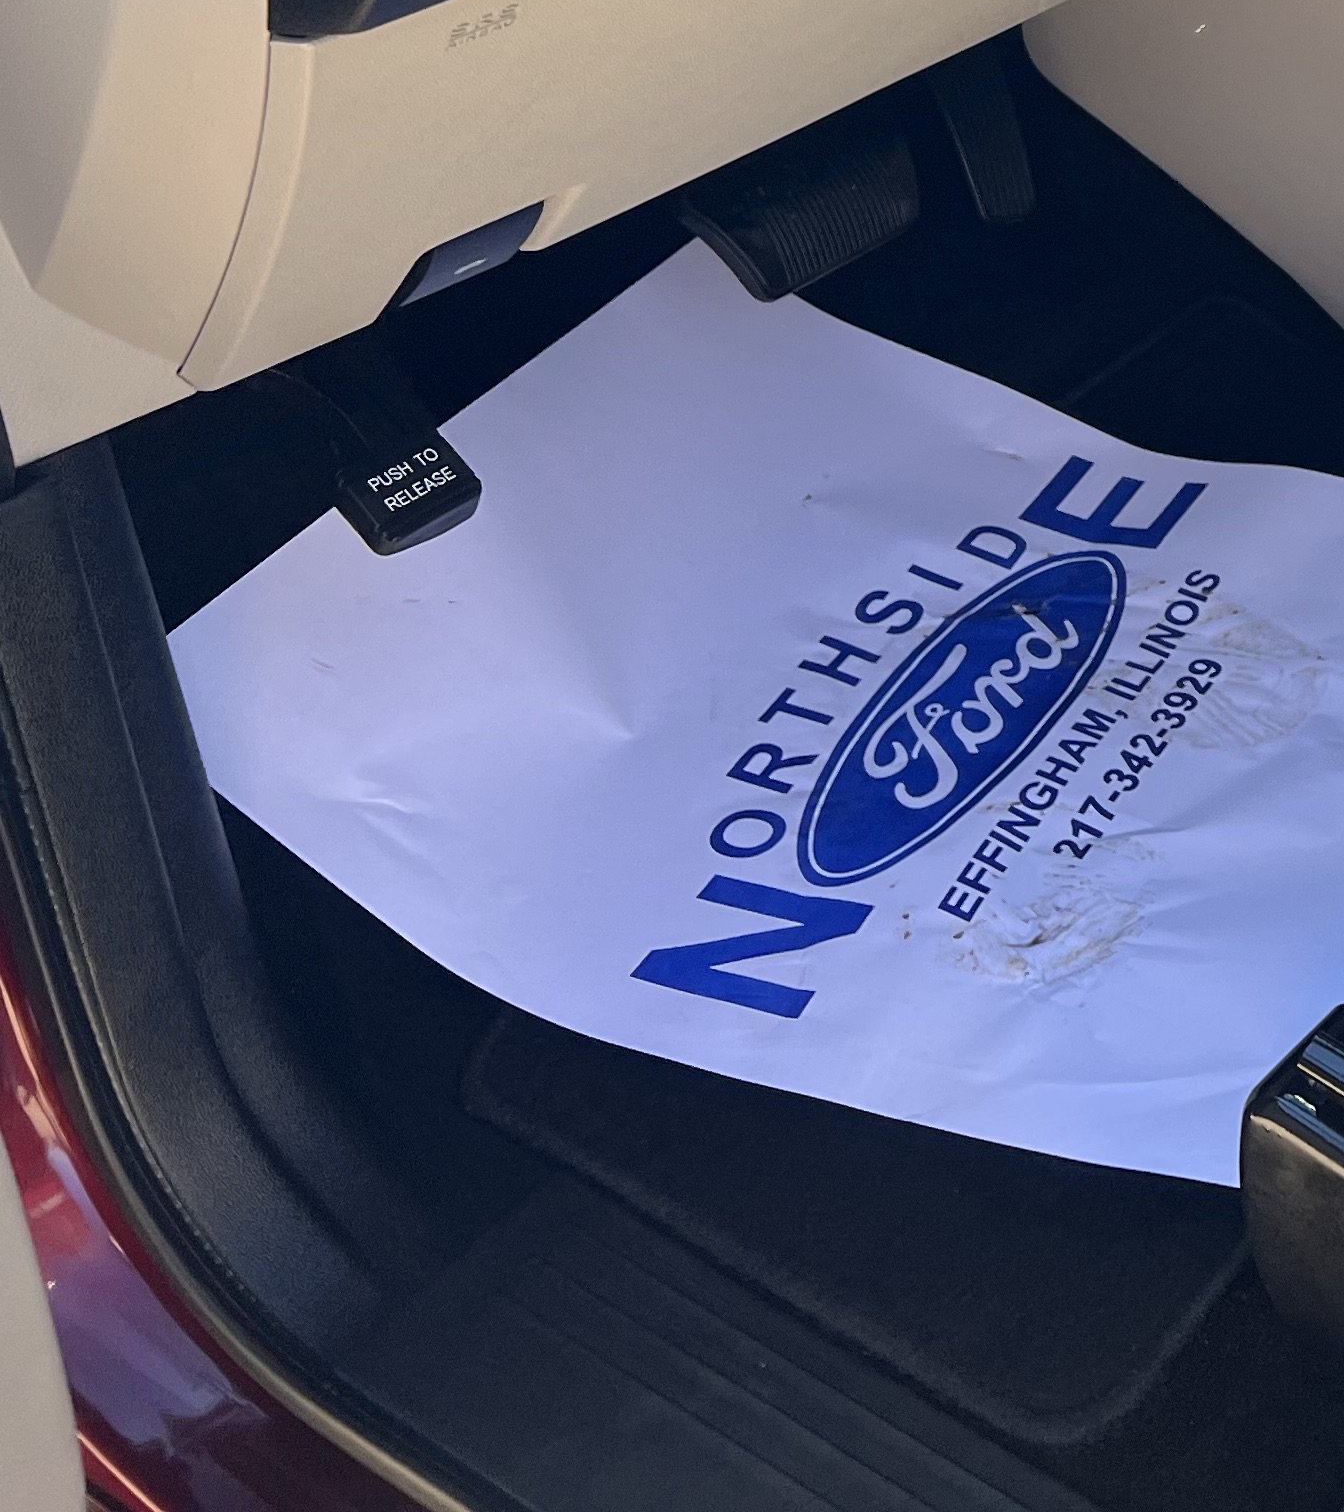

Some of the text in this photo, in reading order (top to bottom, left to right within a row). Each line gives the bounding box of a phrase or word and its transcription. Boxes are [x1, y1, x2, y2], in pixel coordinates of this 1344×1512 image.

[367, 447, 439, 492] PUSH TO
[383, 465, 457, 512] RELEASE
[630, 455, 1208, 1019] NORTHSIDE
[863, 602, 1080, 809] Ford
[938, 570, 1220, 922] EFFINGHAM, ILLINOIS
[1053, 659, 1222, 860] 217-342-3929
